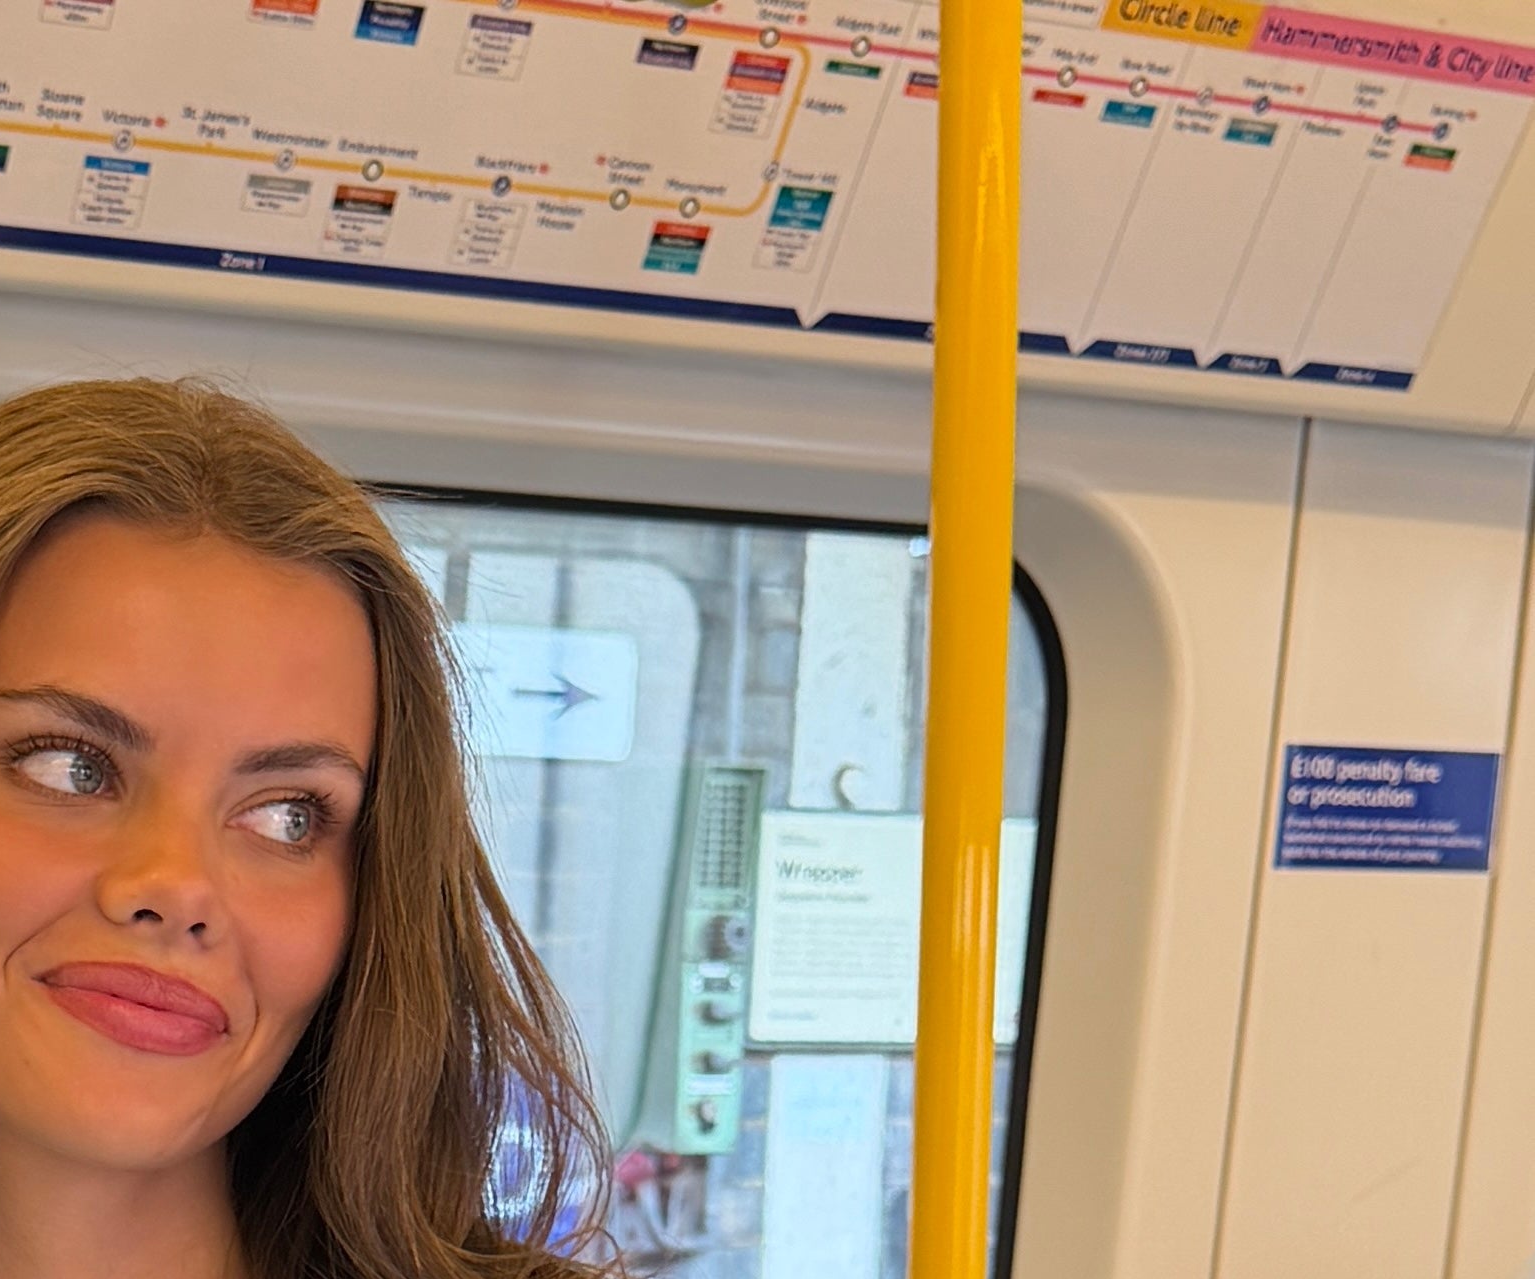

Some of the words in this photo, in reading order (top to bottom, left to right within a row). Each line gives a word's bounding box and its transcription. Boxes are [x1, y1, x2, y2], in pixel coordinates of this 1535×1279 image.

[1119, 0, 1189, 30] Circle
[1196, 3, 1241, 38] line
[1265, 17, 1421, 66] Hammersmith
[1422, 43, 1442, 69] &
[1446, 46, 1493, 81] City
[1496, 50, 1535, 84] line
[219, 251, 255, 270] Zone
